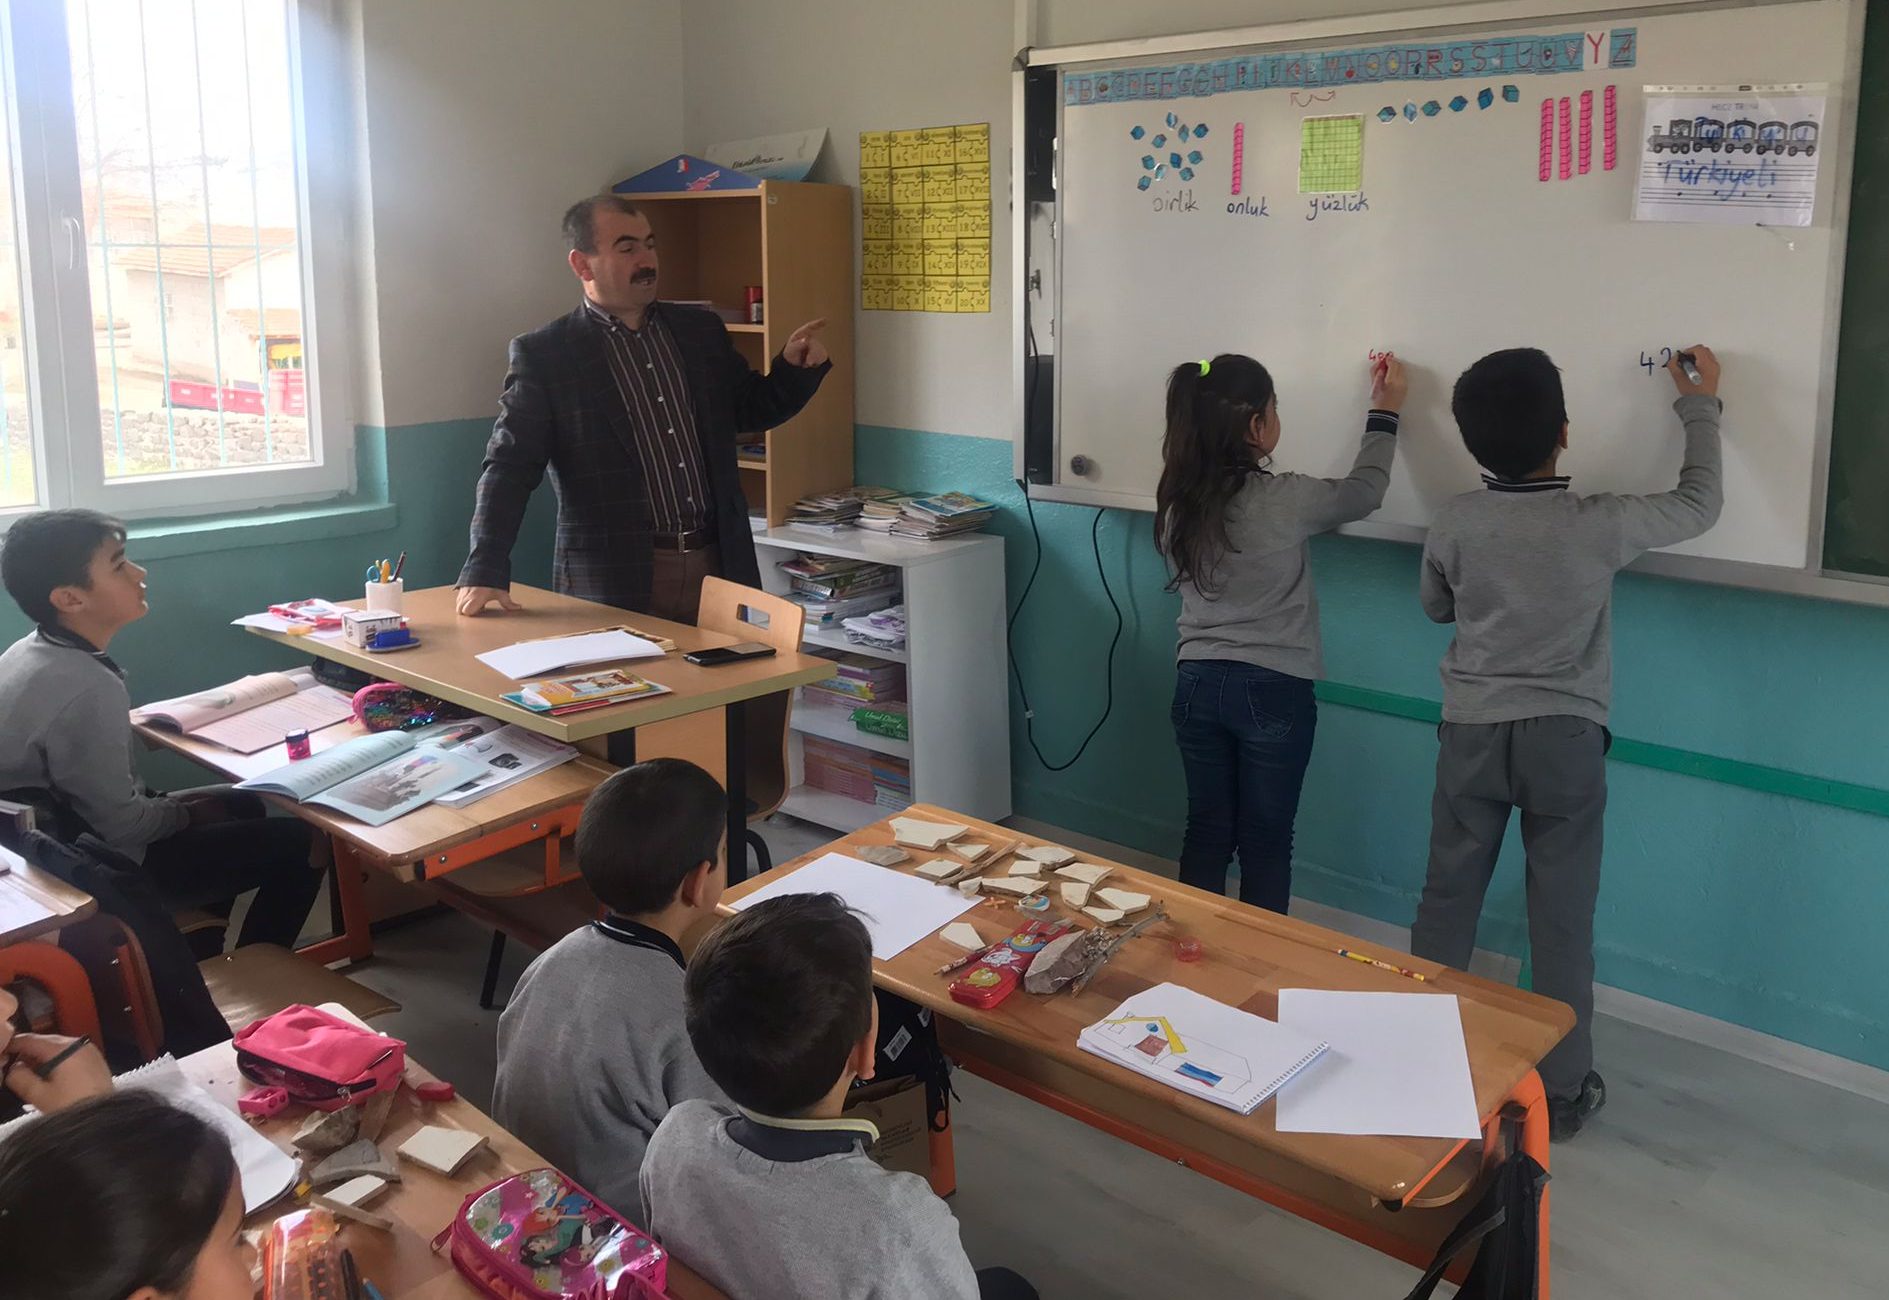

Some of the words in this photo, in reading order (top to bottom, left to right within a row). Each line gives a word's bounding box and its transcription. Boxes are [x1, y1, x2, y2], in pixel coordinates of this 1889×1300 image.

[1586, 31, 1605, 65] Y
[1226, 196, 1270, 217] onluk
[1305, 192, 1370, 221] yüzlük
